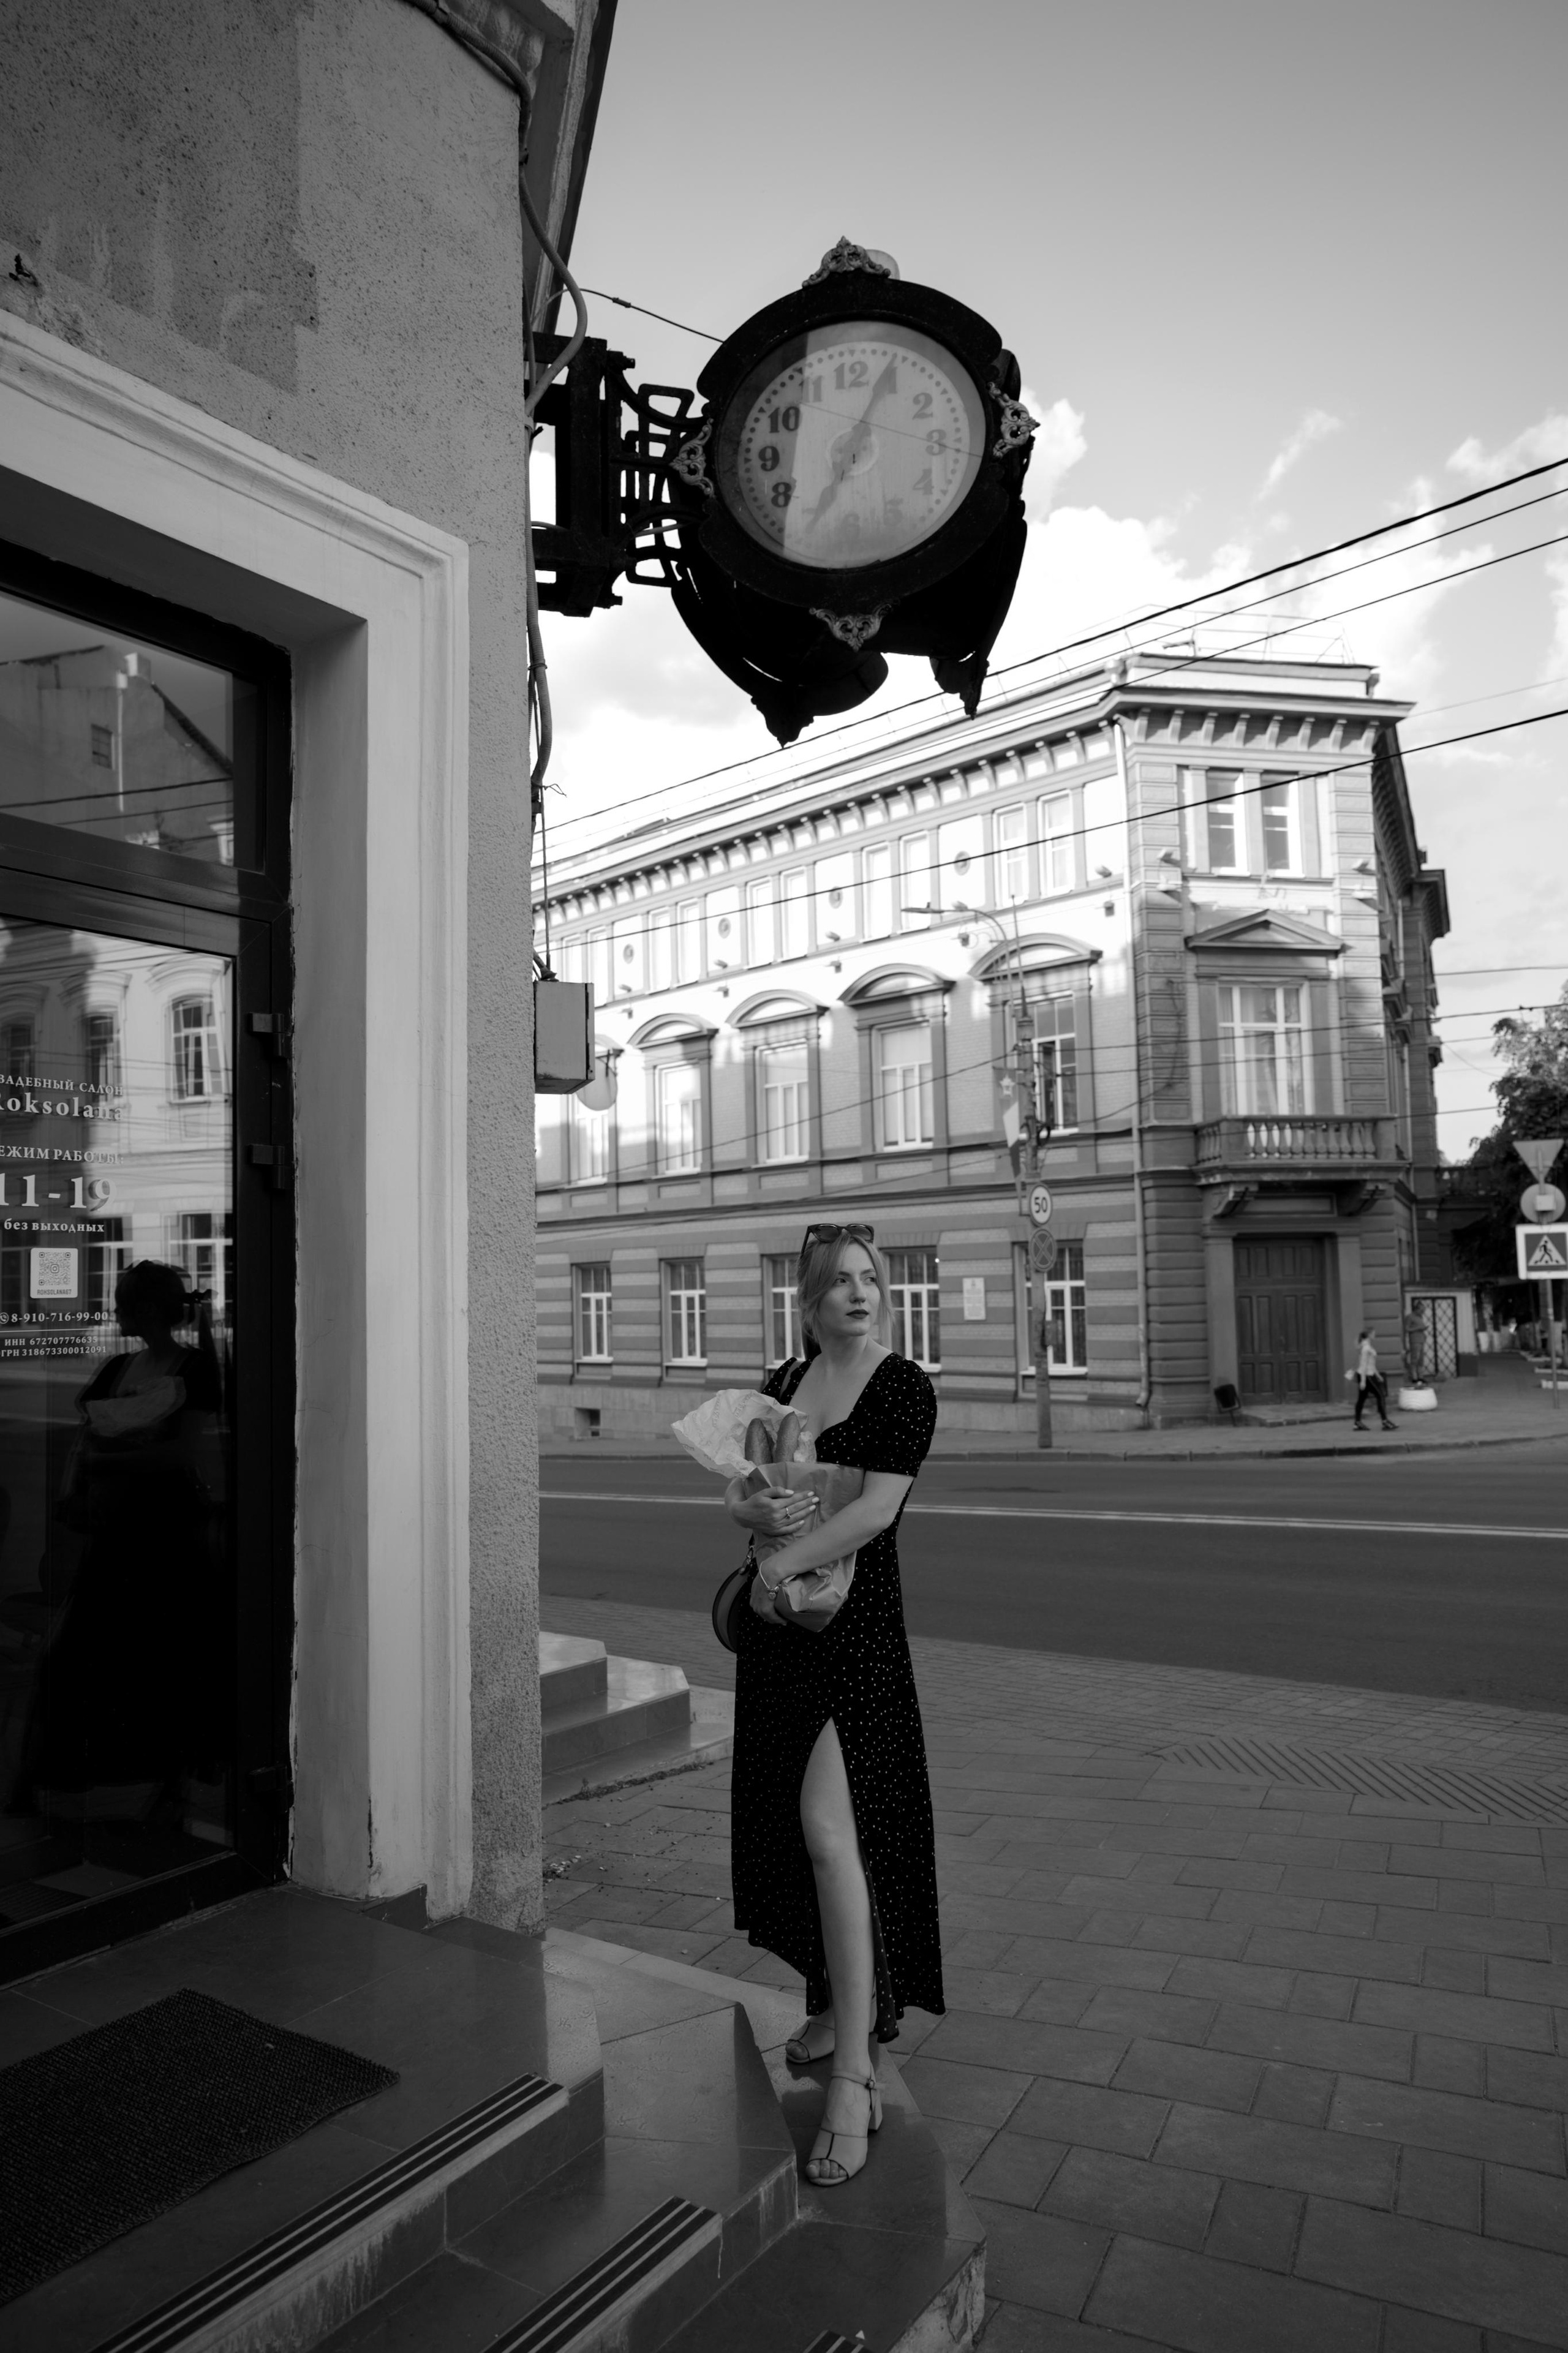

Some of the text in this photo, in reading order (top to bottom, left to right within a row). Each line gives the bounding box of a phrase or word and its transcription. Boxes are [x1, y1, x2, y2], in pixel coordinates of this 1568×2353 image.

[833, 360, 869, 390] 12
[799, 375, 823, 403] 11
[767, 406, 801, 433] 10
[912, 392, 933, 420] 2
[925, 429, 947, 456] 3
[757, 445, 781, 472] 9
[771, 481, 792, 508] 8
[912, 468, 935, 495] 4
[79, 1082, 123, 1096] САЛОН
[1034, 1196, 1048, 1213] 50
[4, 1218, 105, 1233] без выходных
[11, 1311, 109, 1323] 8-910-716-99-00
[0, 1346, 107, 1357] ГРН 318673300012091
[29, 1336, 98, 1346] 672707776635
